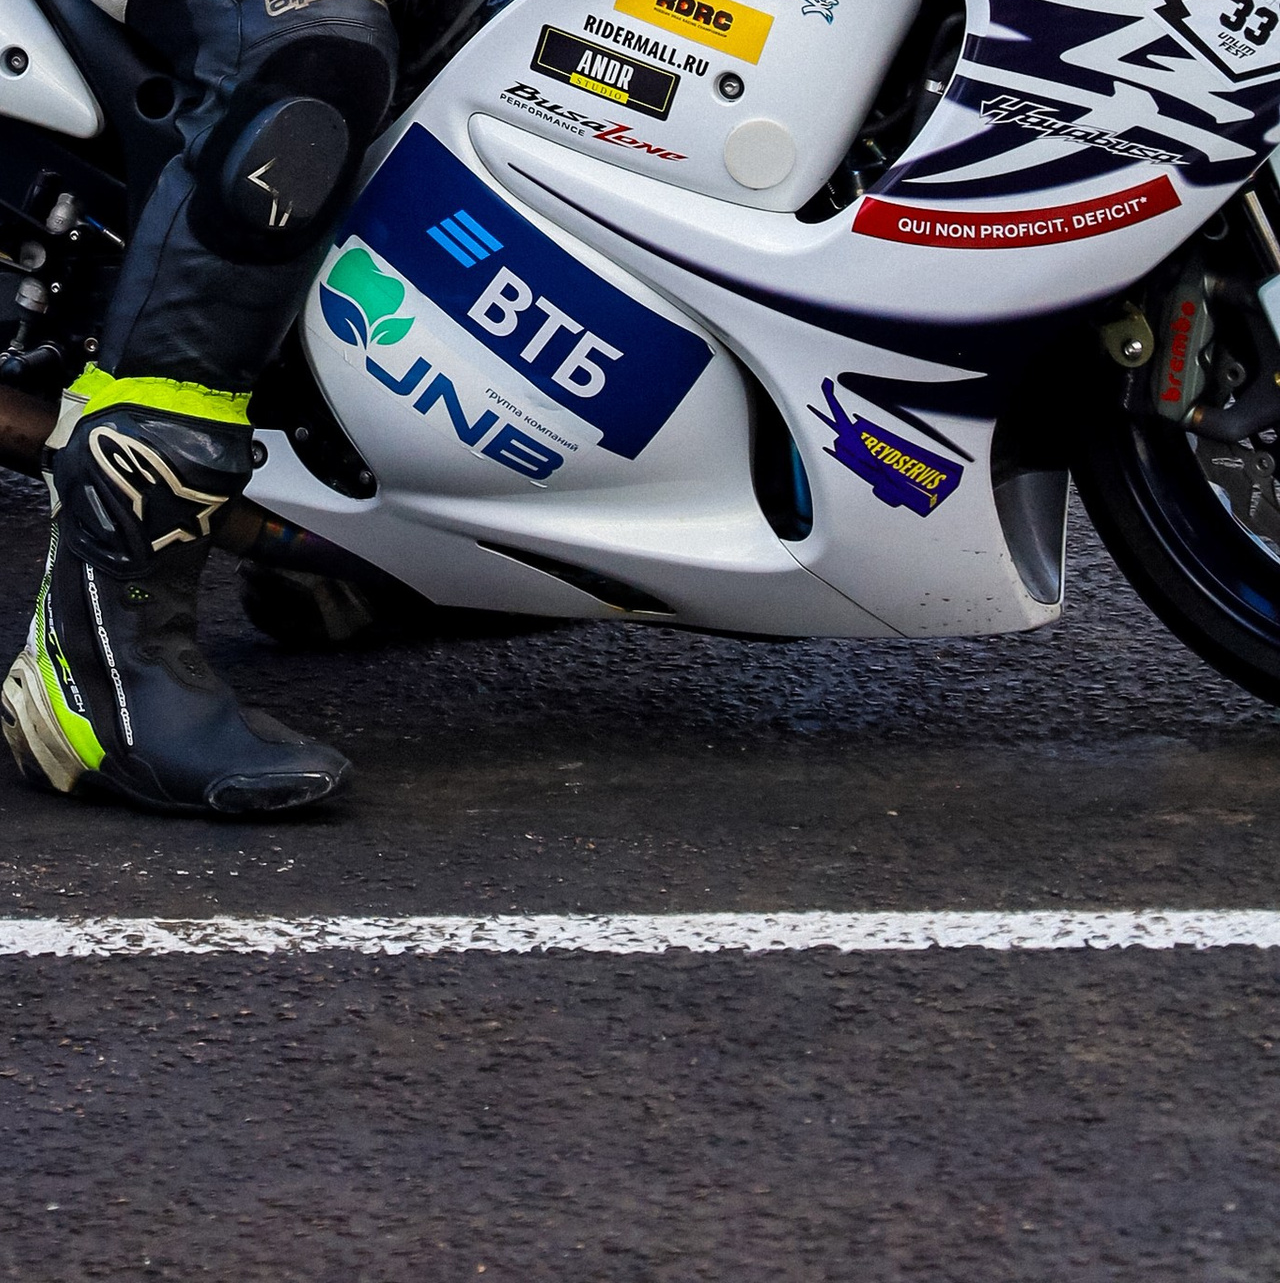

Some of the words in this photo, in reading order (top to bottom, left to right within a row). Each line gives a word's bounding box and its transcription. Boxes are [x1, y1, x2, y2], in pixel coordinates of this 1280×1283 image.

[576, 49, 635, 91] ANDR
[583, 14, 710, 77] RIDERMALL.RU
[1218, 40, 1249, 59] FEST
[499, 93, 586, 137] PERFORMANCE
[575, 76, 623, 101] STUDIO
[979, 94, 1191, 165] Hayabusa
[897, 217, 931, 236] QUI
[935, 223, 975, 239] NON
[980, 218, 1069, 240] PROFICIT,
[467, 265, 625, 398] ВТБ
[1160, 301, 1196, 403] brembo
[485, 387, 522, 418] группа
[523, 414, 578, 453] компаний
[860, 431, 947, 489] TREYDSERVIS
